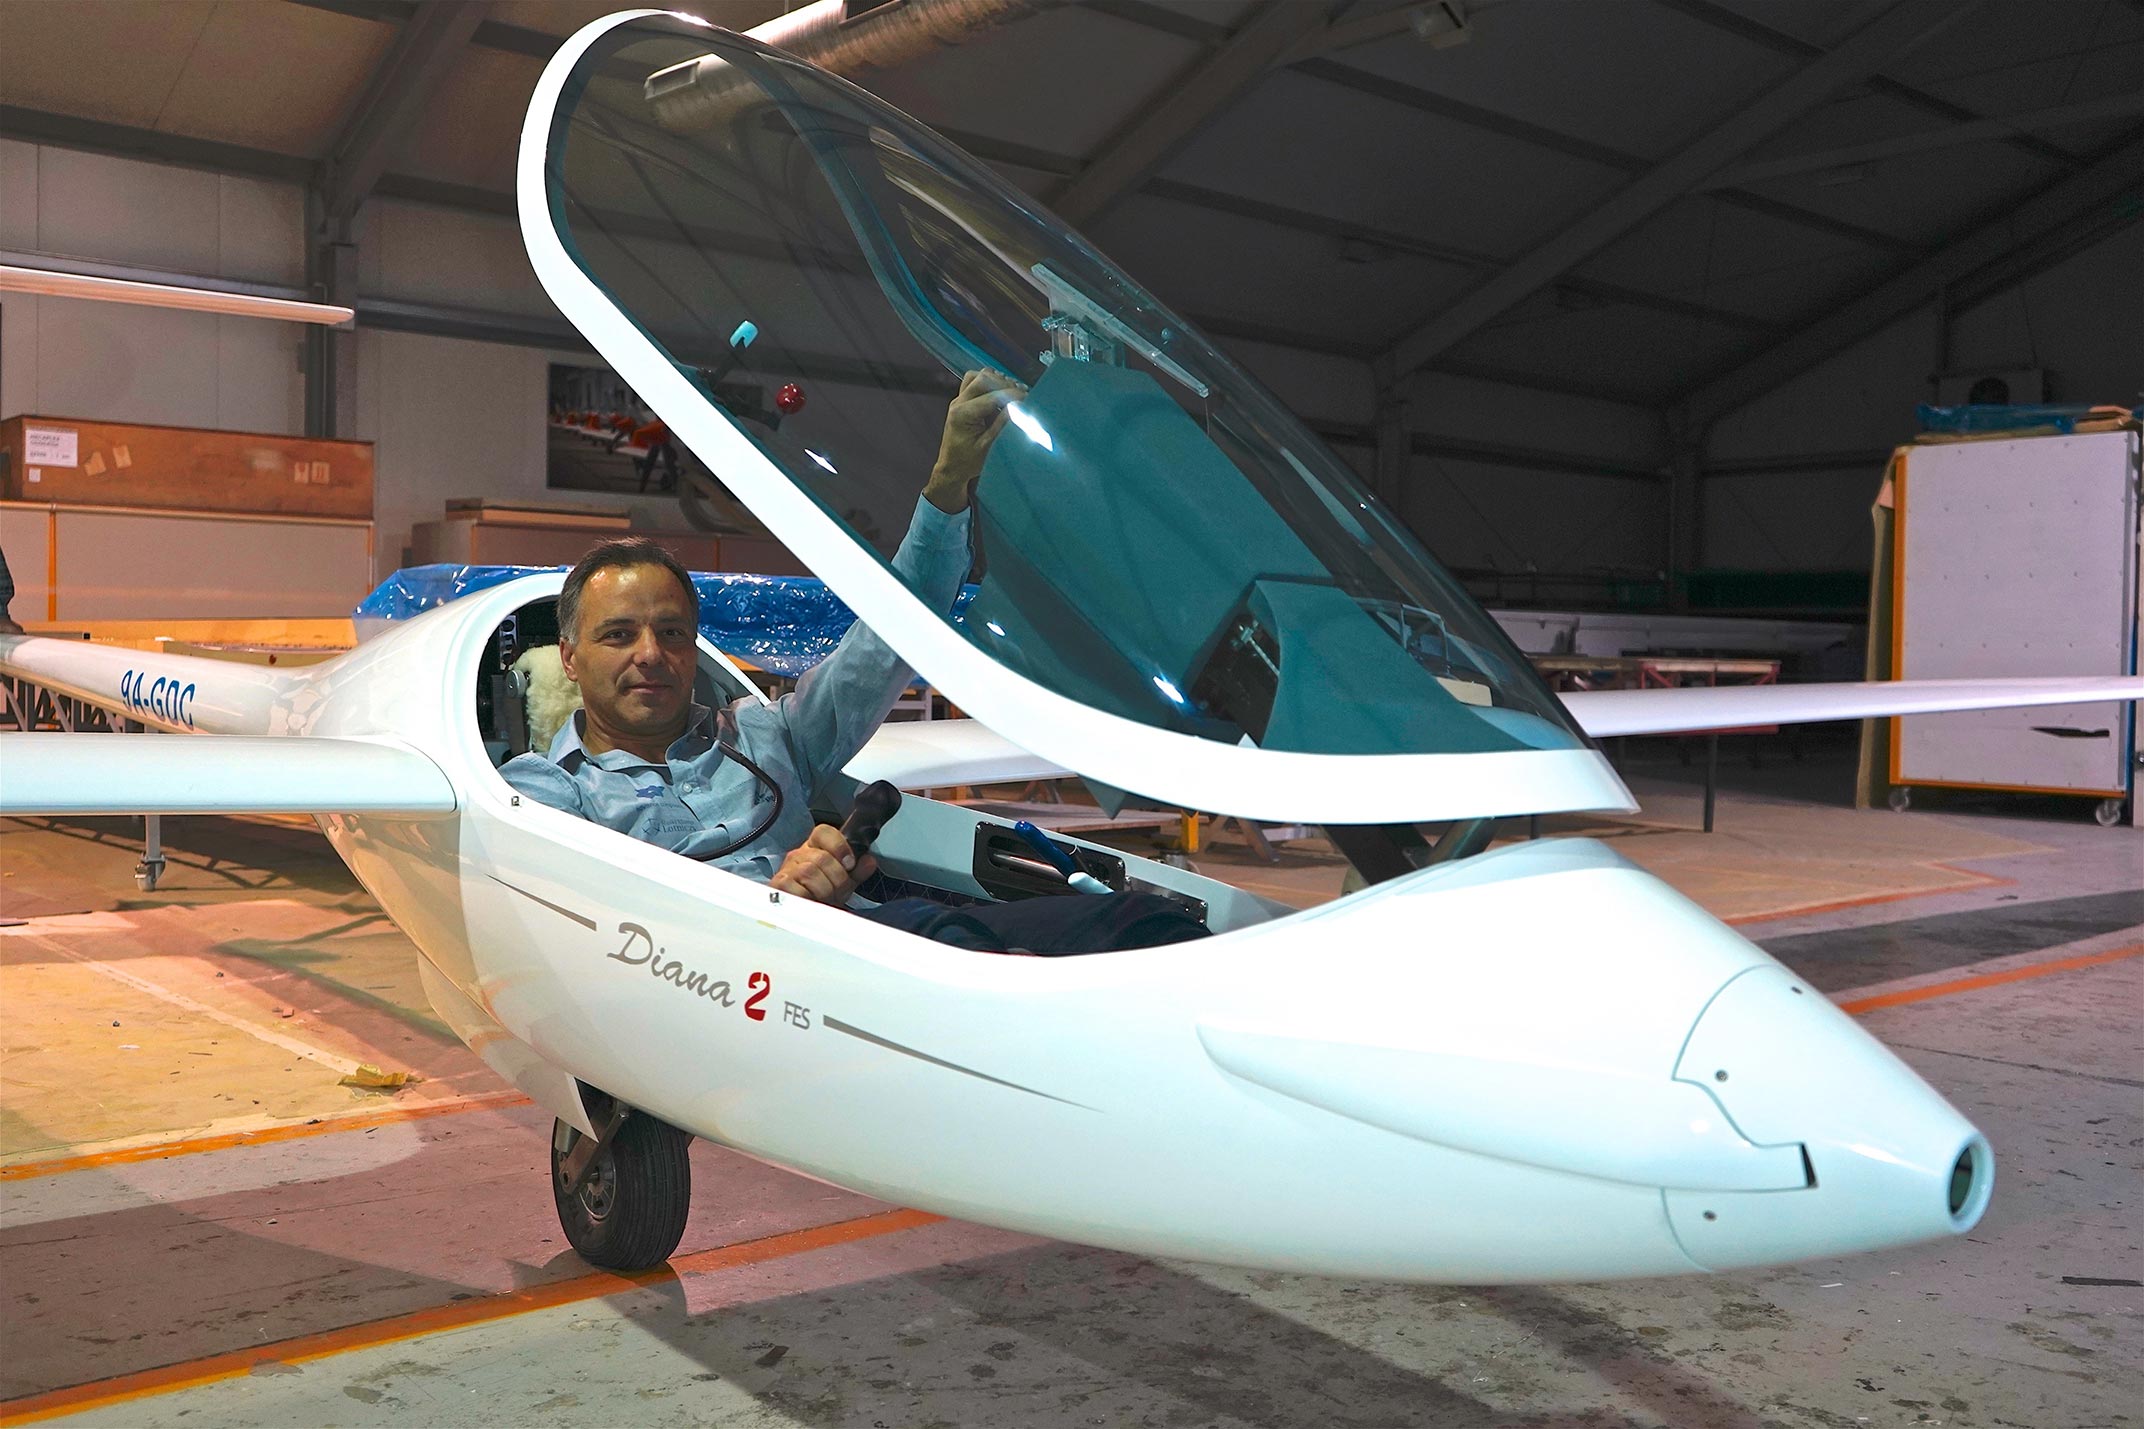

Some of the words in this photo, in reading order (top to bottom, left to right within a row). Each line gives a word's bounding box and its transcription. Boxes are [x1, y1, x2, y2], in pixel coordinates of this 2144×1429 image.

[606, 922, 736, 1008] Diana
[744, 972, 771, 1022] 2
[783, 1001, 812, 1030] FES
